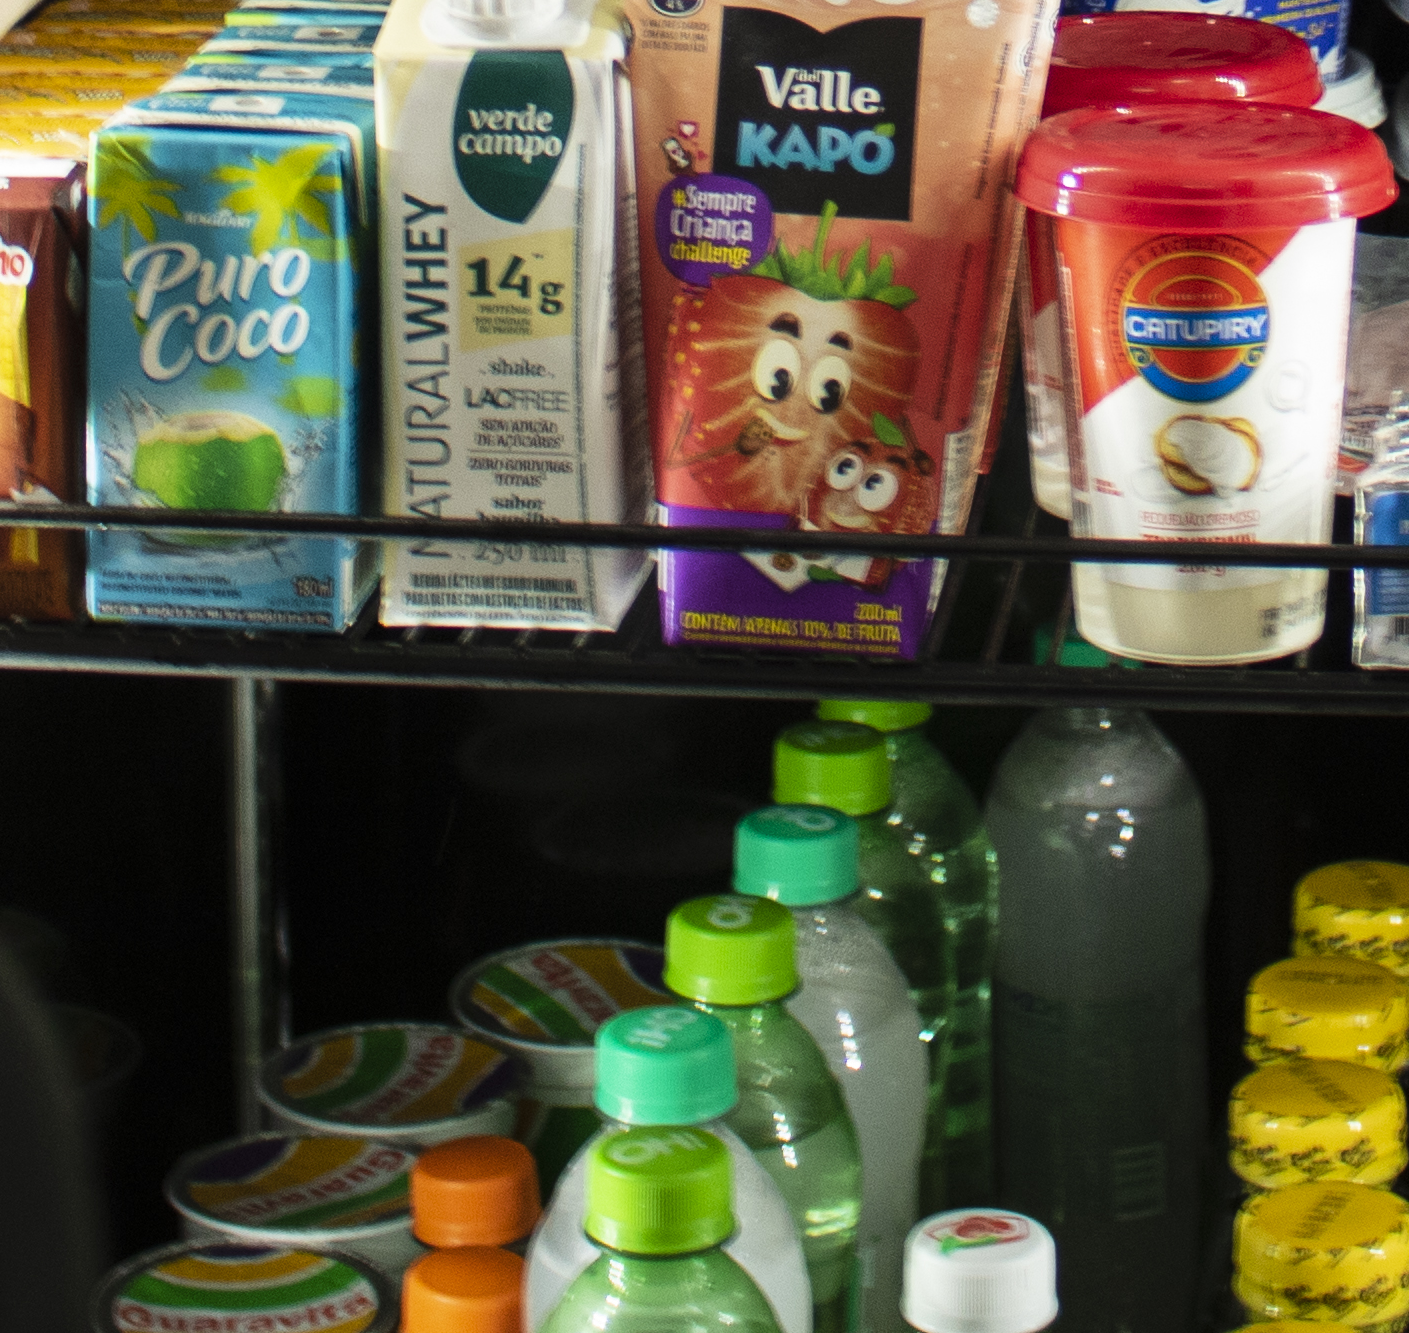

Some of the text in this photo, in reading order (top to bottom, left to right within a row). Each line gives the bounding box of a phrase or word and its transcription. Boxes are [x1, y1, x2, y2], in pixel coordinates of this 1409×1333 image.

[755, 64, 883, 114] Valle
[467, 102, 554, 133] verde
[457, 133, 563, 165] campo
[672, 183, 757, 217] #Sempre
[670, 238, 752, 269] challenge
[122, 241, 311, 321] Puro
[140, 301, 311, 381] Coco
[1127, 313, 1268, 341] CATUPIRY
